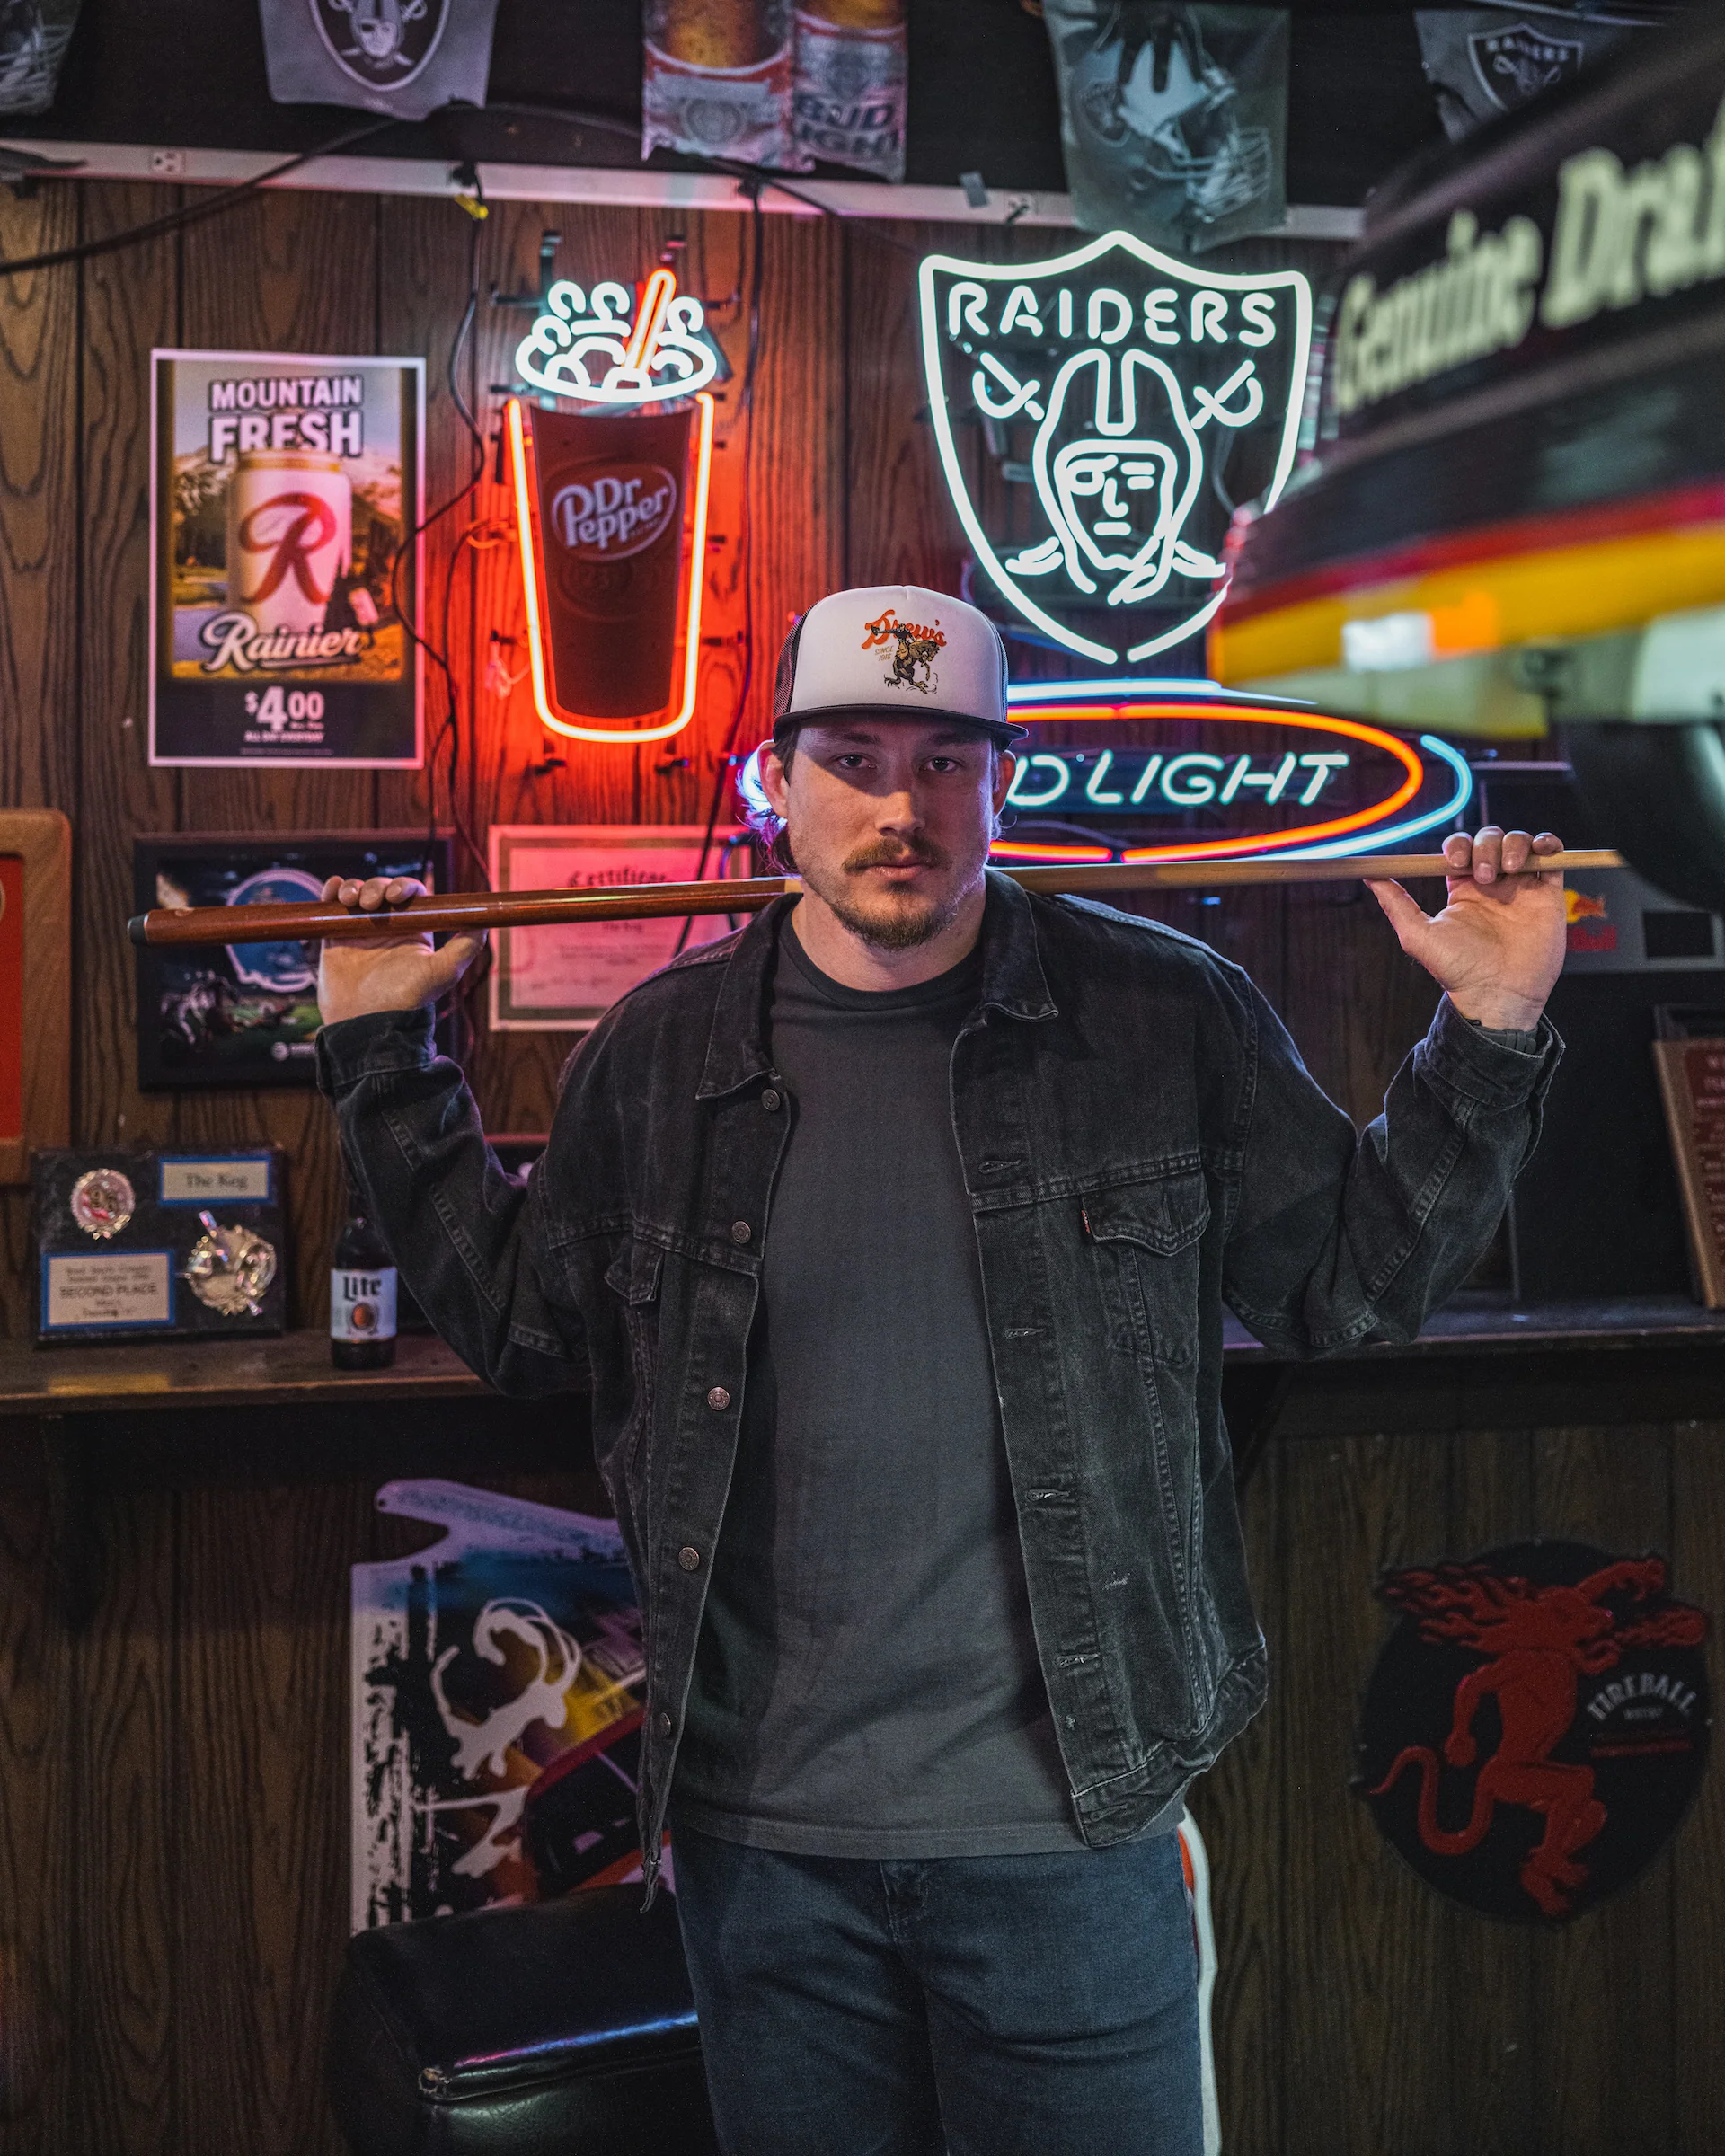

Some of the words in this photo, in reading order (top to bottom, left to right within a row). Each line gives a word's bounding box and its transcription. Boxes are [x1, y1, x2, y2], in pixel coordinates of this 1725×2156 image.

[948, 280, 1277, 348] RAIDERS
[210, 376, 362, 411] MOUNTAIN
[210, 411, 362, 463] FRESH
[551, 483, 669, 550] Pepper
[593, 477, 642, 516] Dr
[200, 611, 362, 672] Rainier
[874, 645, 895, 656] SINCE
[1085, 749, 1349, 807] LIGHT
[59, 1284, 113, 1299] SECOND
[116, 1282, 157, 1296] PLACE
[342, 1276, 382, 1303] Lite
